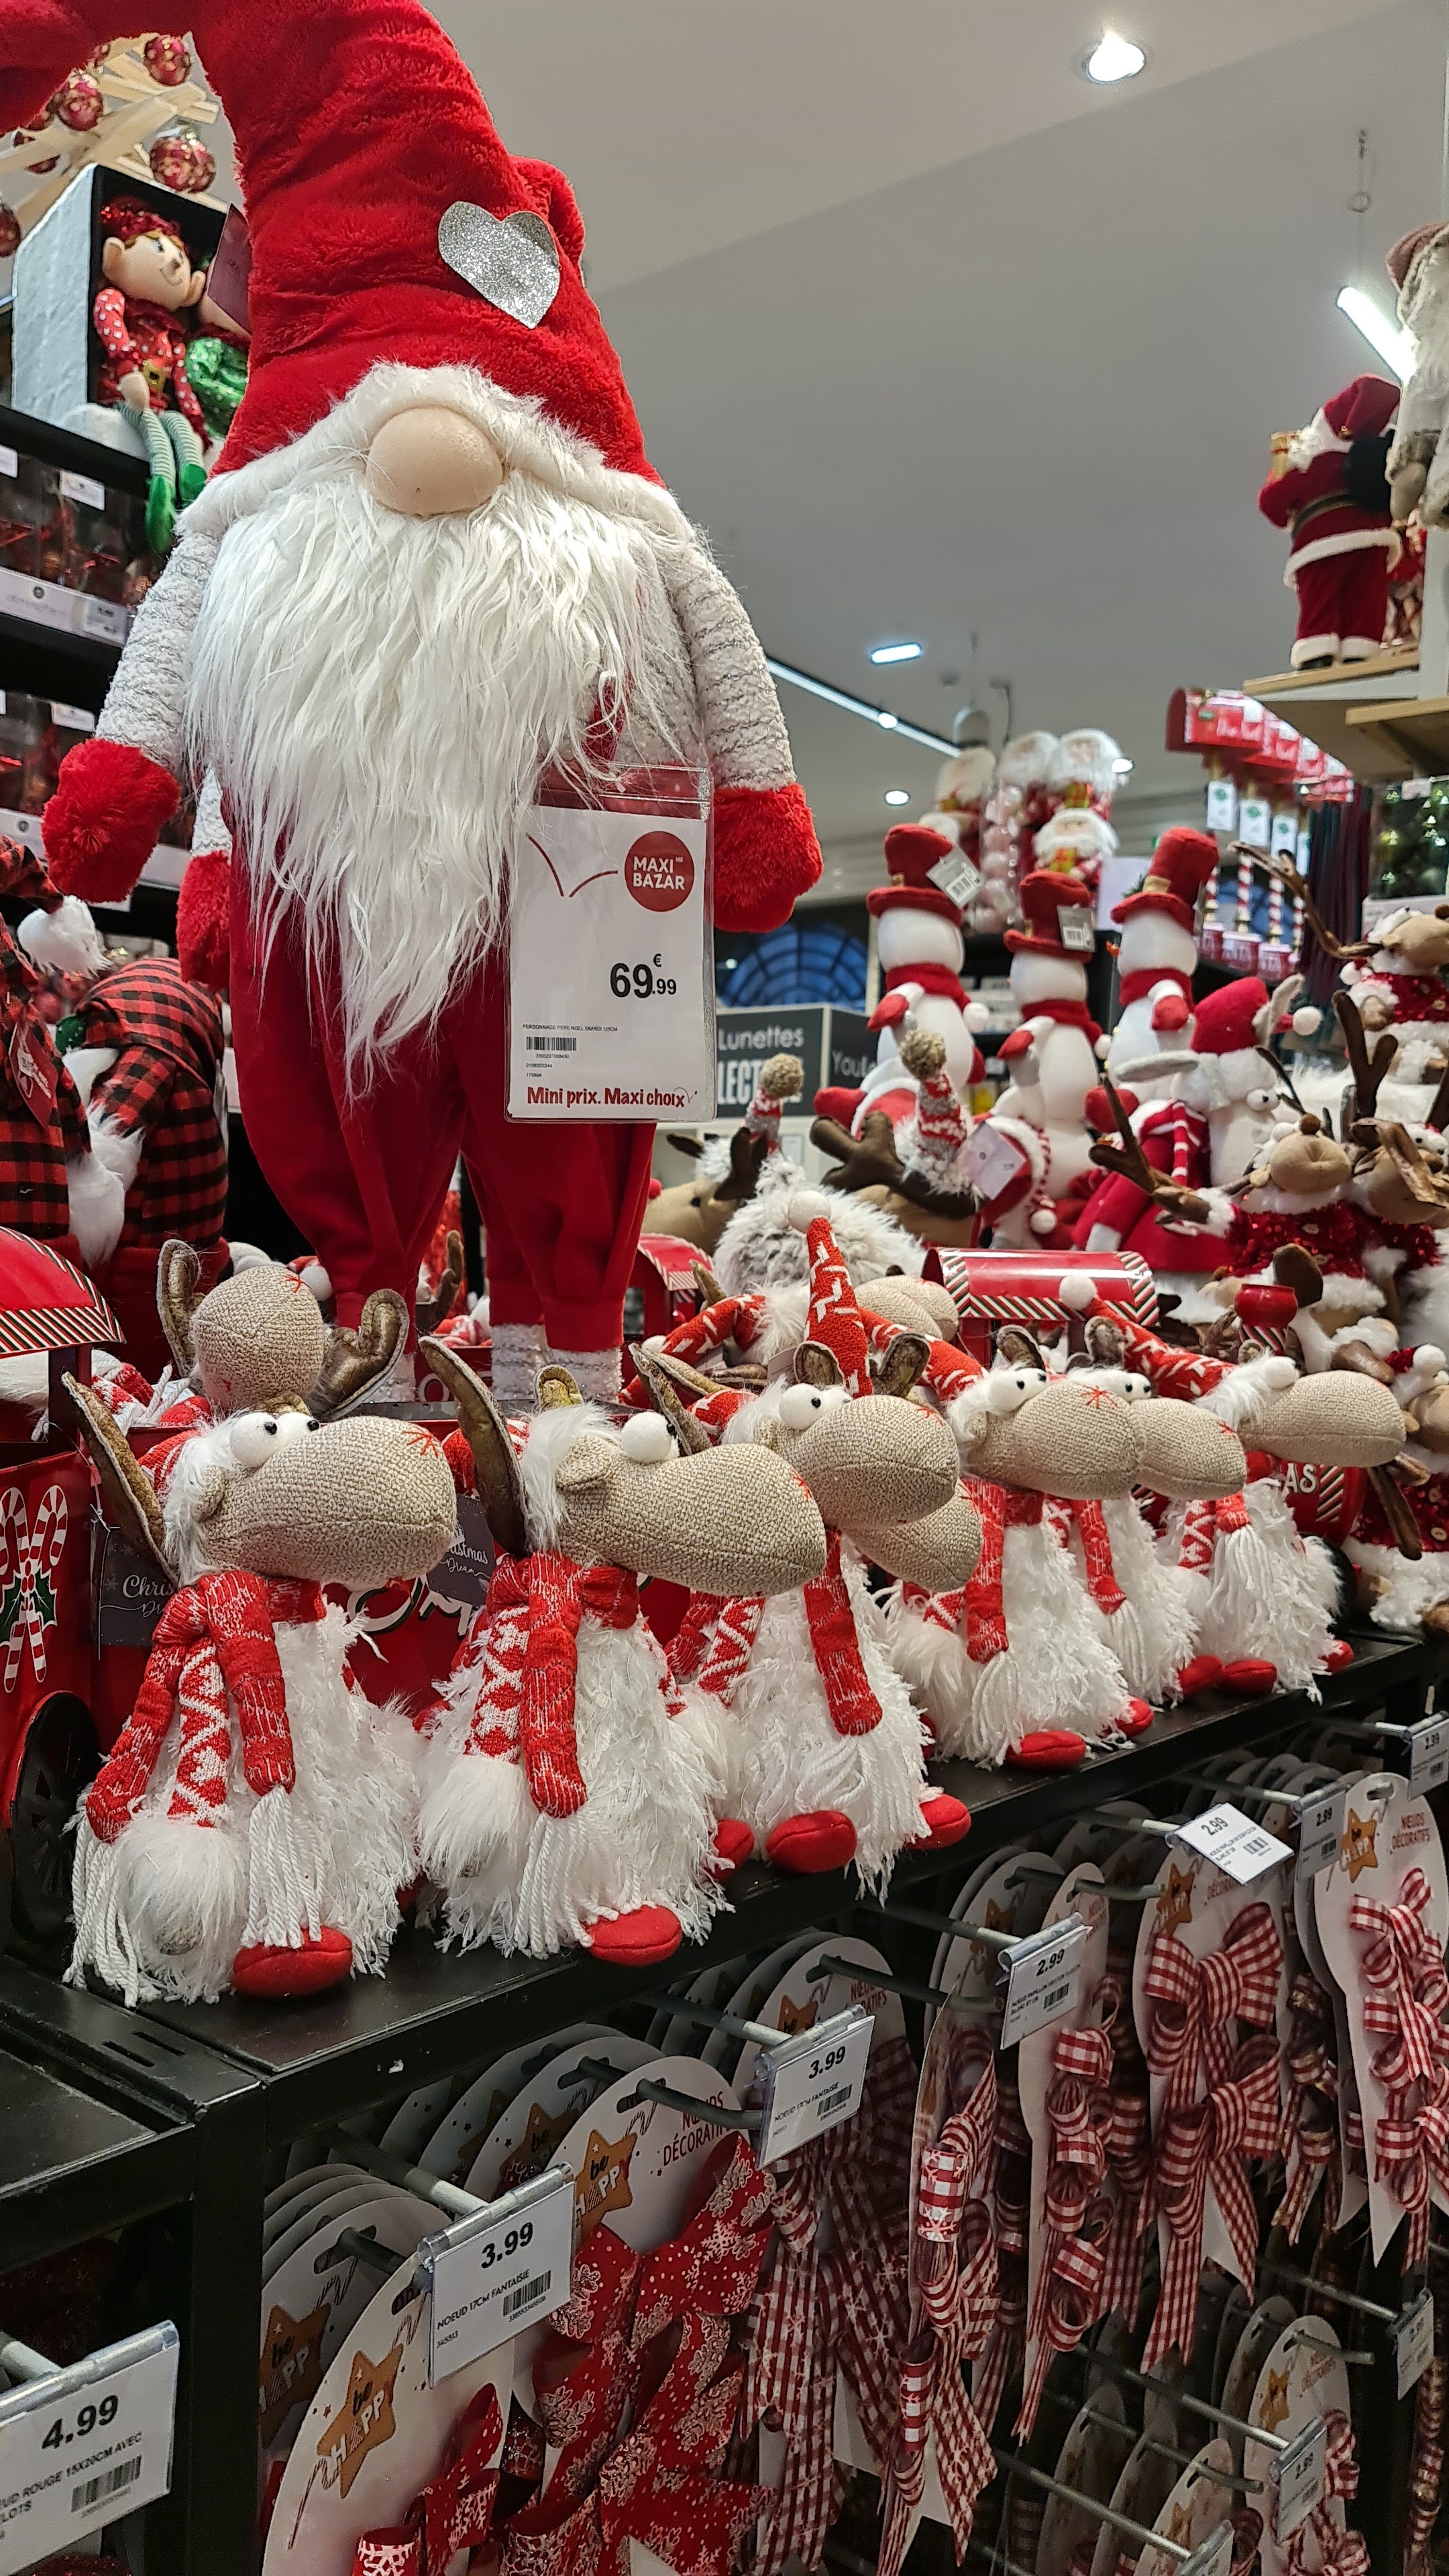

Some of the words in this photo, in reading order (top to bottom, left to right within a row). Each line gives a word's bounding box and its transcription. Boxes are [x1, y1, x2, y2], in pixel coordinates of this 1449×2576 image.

[633, 855, 674, 873] MAXI
[633, 872, 685, 890] BAZAR
[718, 1026, 805, 1051] Lunettes
[527, 1086, 564, 1104] Mini
[567, 1088, 601, 1108] prix.
[604, 1087, 644, 1105] Maxi
[647, 1088, 685, 1108] choix
[1200, 1817, 1228, 1836] 2.99
[1036, 1949, 1065, 1977] 2.99
[808, 2045, 846, 2080] 3.99
[481, 2222, 533, 2269] 3.99
[437, 2306, 468, 2330] NOEUD
[492, 2269, 530, 2298] FANTAISIE
[42, 2394, 119, 2450] 4.99
[22, 2471, 63, 2498] ROUGE
[114, 2431, 143, 2453] AVEC
